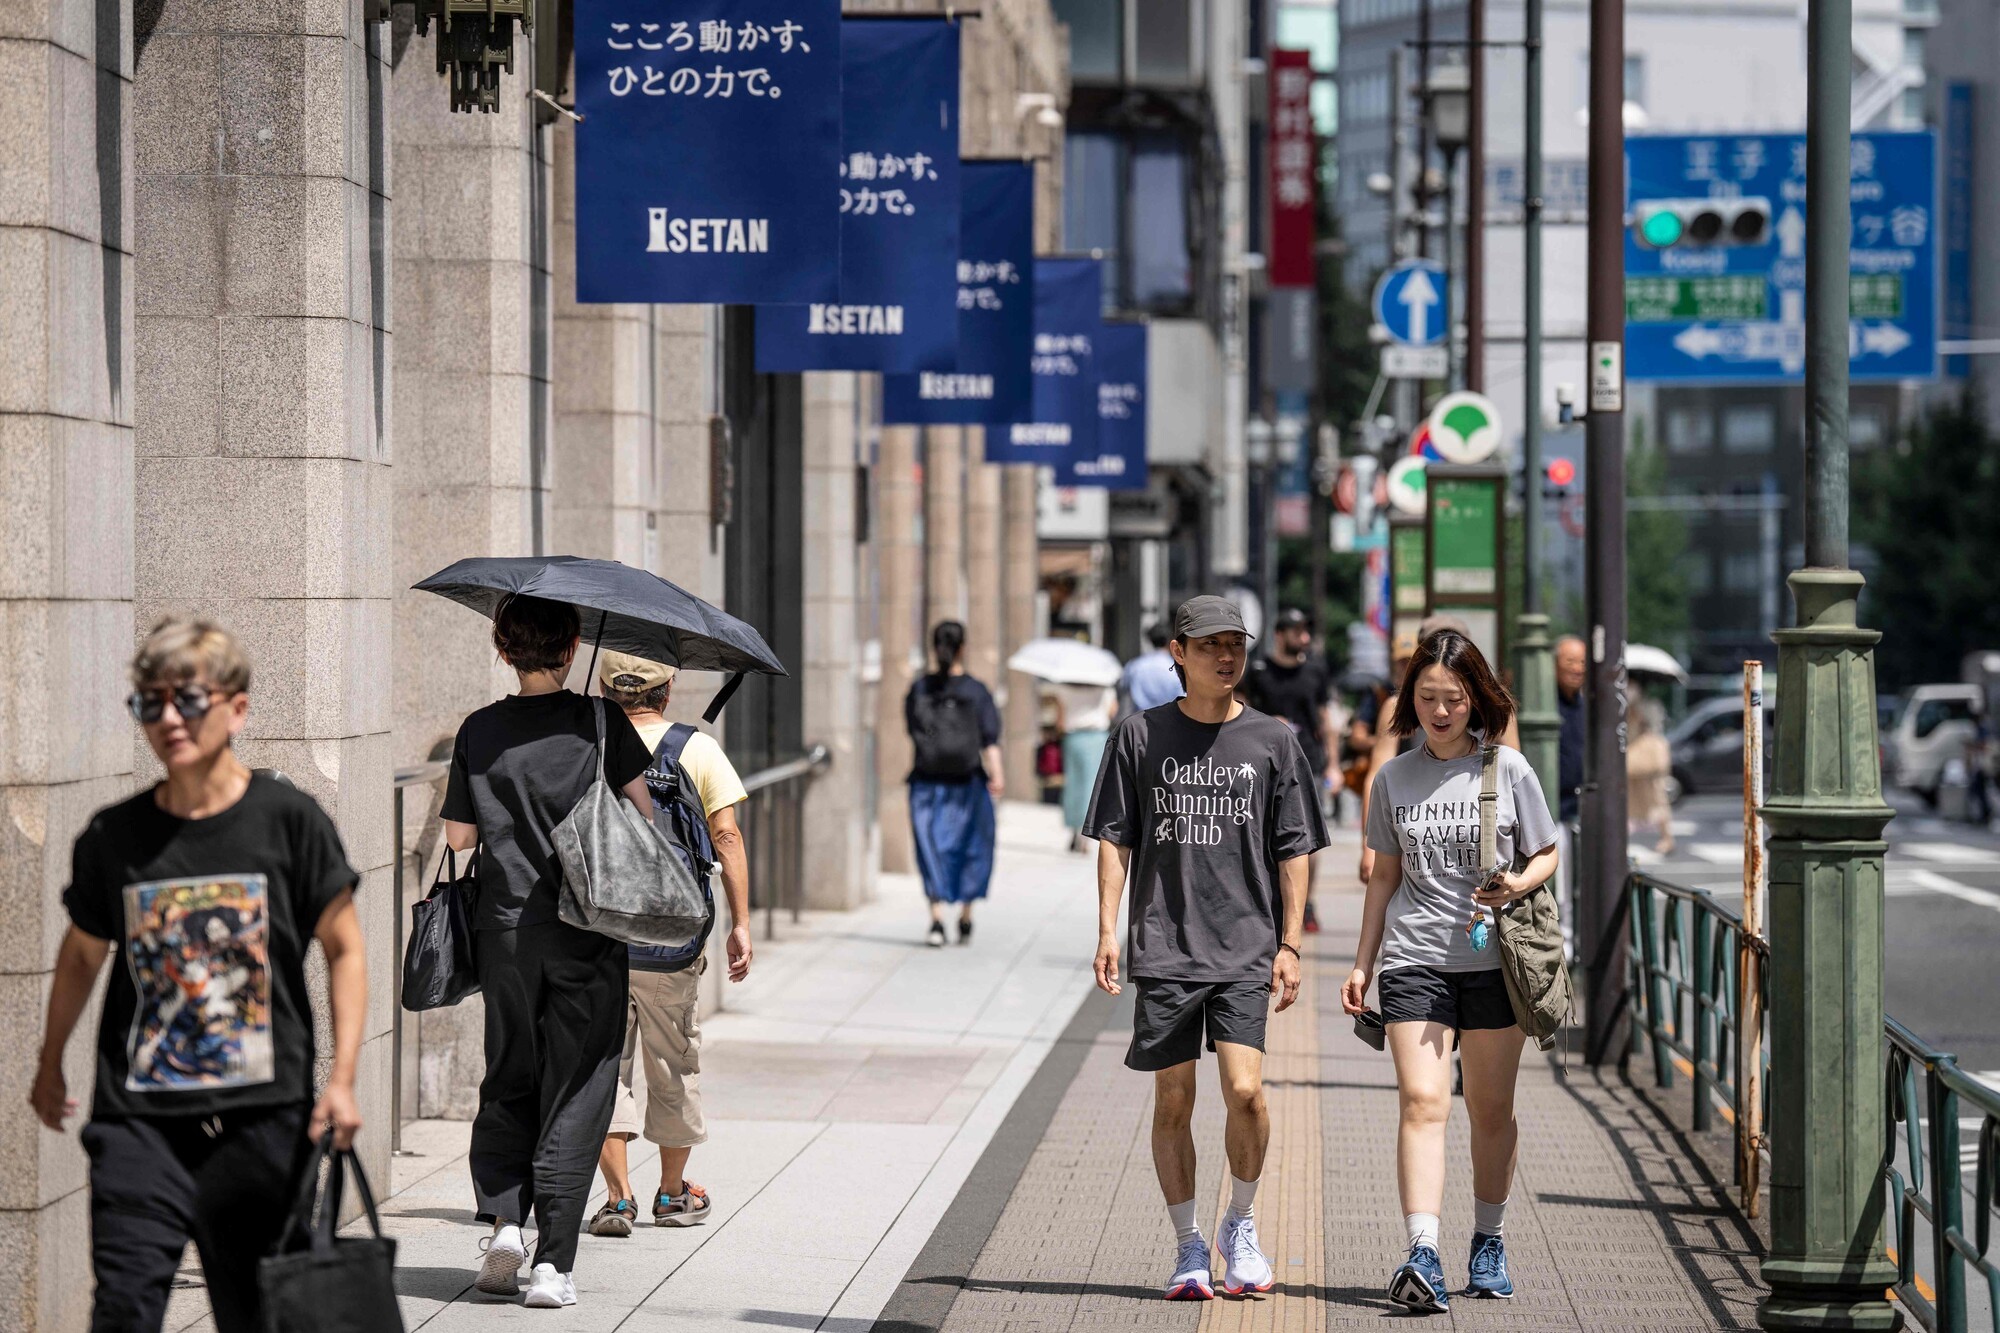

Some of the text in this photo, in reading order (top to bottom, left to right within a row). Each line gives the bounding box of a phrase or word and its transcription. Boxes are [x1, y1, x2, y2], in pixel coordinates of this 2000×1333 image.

[607, 20, 811, 53] こころ動かす、
[607, 65, 782, 99] ひとの力で。
[840, 152, 938, 181] 動かす、
[646, 207, 769, 254] ISETAN
[807, 303, 904, 335] ISETAN
[1161, 756, 1240, 795] Oakley
[1152, 786, 1247, 826] Running
[1395, 801, 1498, 825] RUNNIN
[1174, 814, 1222, 846] Club
[1406, 824, 1481, 848] SAVED
[1405, 848, 1482, 872] MY LIF
